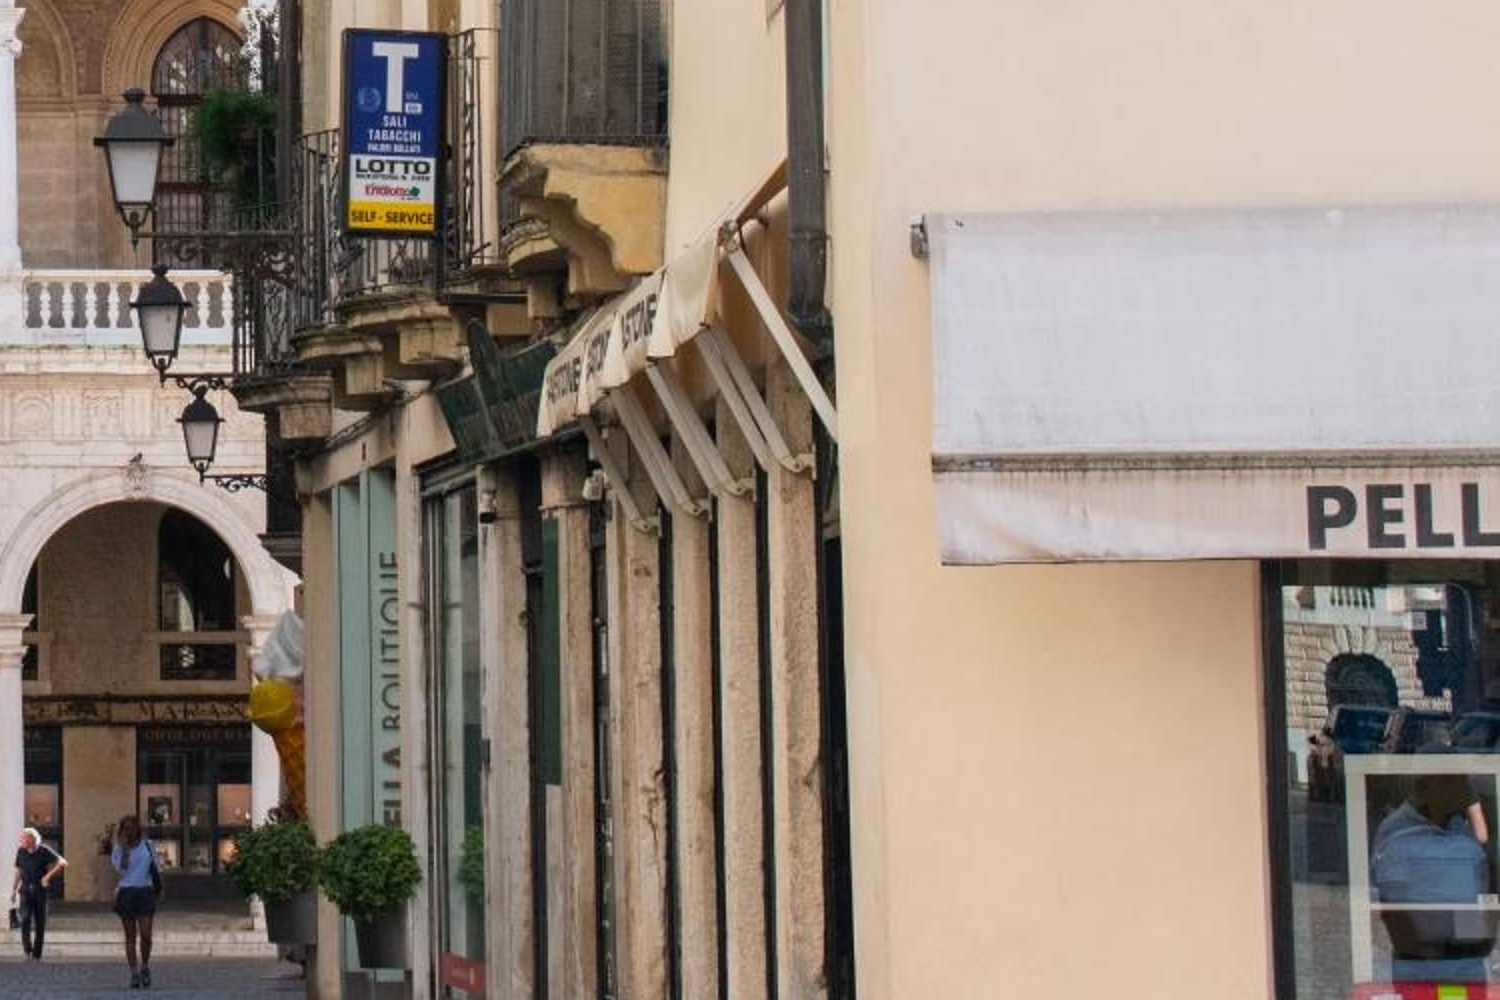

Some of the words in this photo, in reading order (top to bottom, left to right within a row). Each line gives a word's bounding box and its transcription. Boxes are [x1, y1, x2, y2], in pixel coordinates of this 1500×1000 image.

[372, 41, 420, 112] T
[382, 115, 407, 127] SALI
[367, 128, 421, 142] TABACCHI
[355, 158, 431, 175] LOTTO
[350, 208, 377, 222] SELF
[385, 211, 435, 225] SERVICE
[1307, 483, 1500, 550] PELL
